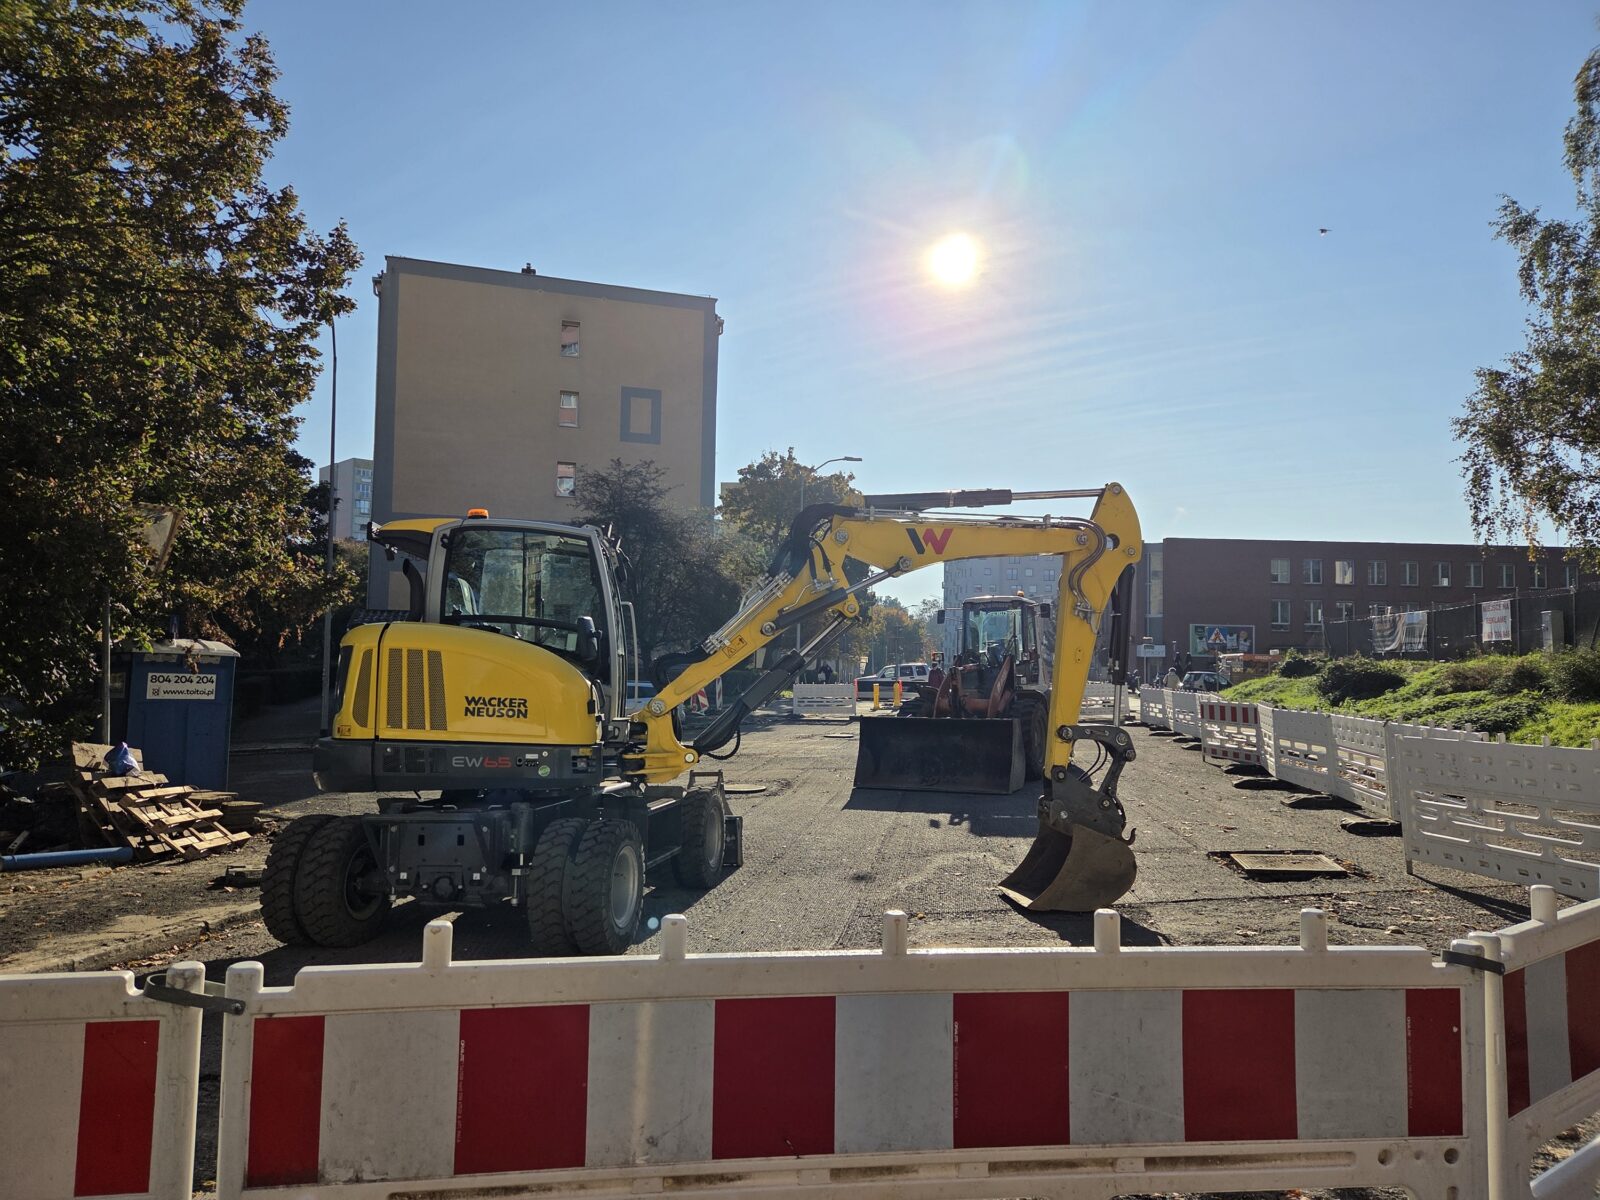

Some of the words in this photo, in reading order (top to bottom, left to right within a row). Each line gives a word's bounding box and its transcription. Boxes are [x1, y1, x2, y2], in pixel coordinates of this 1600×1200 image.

[150, 674, 172, 684] 804
[174, 675, 194, 684] 204
[196, 675, 215, 684] 204
[162, 688, 214, 697] www.toitoi.pl
[464, 696, 528, 708] WACKER
[464, 707, 528, 718] NEUSON
[452, 756, 512, 768] EW65
